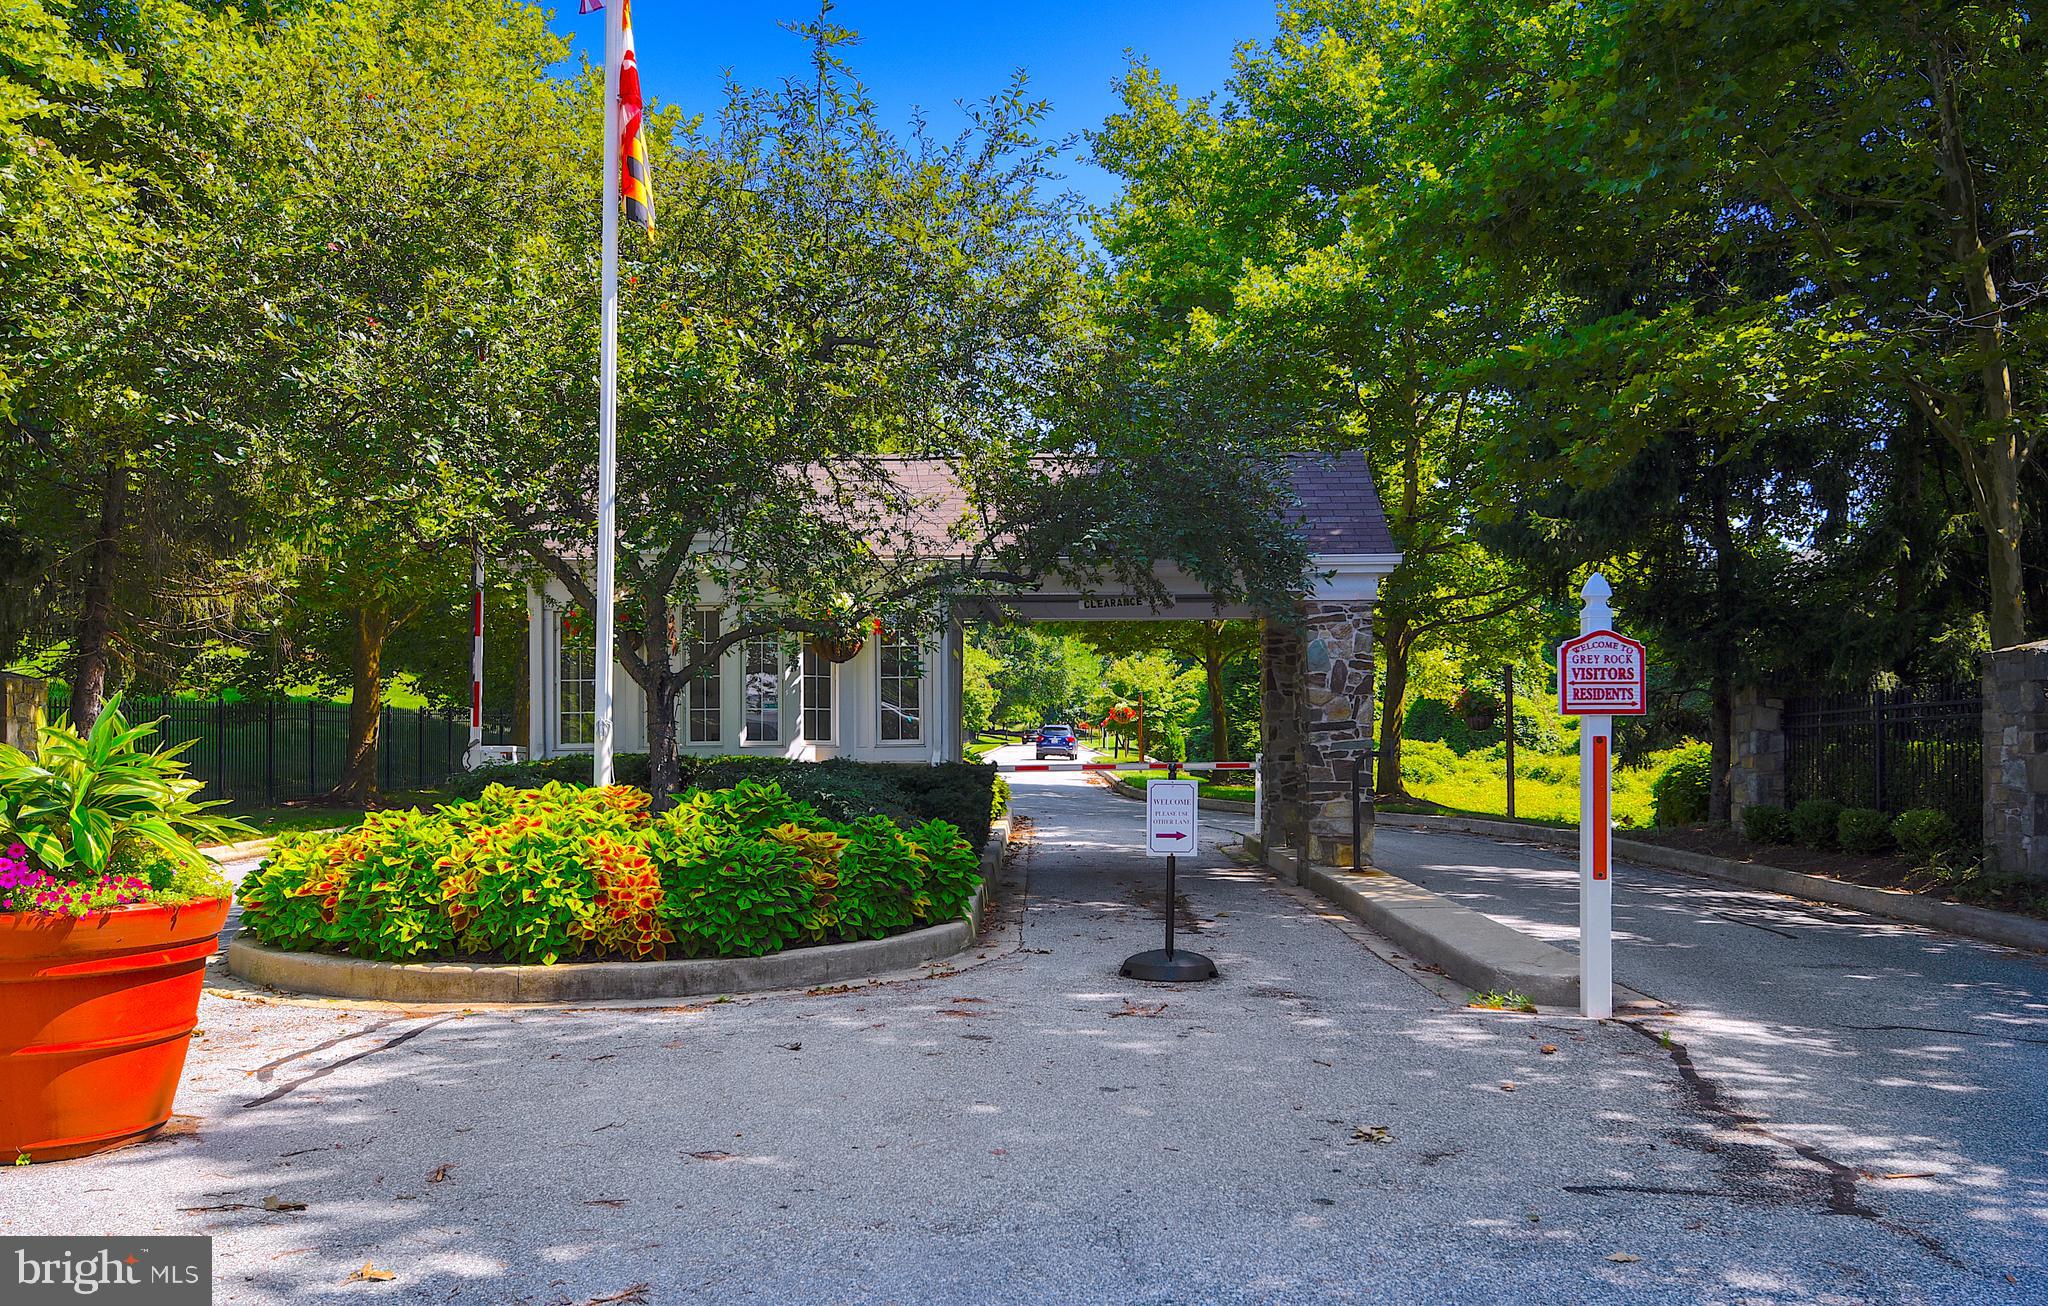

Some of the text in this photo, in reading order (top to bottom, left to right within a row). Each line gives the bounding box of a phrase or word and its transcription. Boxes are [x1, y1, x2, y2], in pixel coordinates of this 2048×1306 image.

[1083, 597, 1143, 609] CLEARANCE
[1571, 641, 1634, 654] WELCOME TO
[1572, 654, 1633, 664] GREY ROCK
[1571, 667, 1634, 680] VISITORS
[1573, 687, 1634, 700] RESIDENTS
